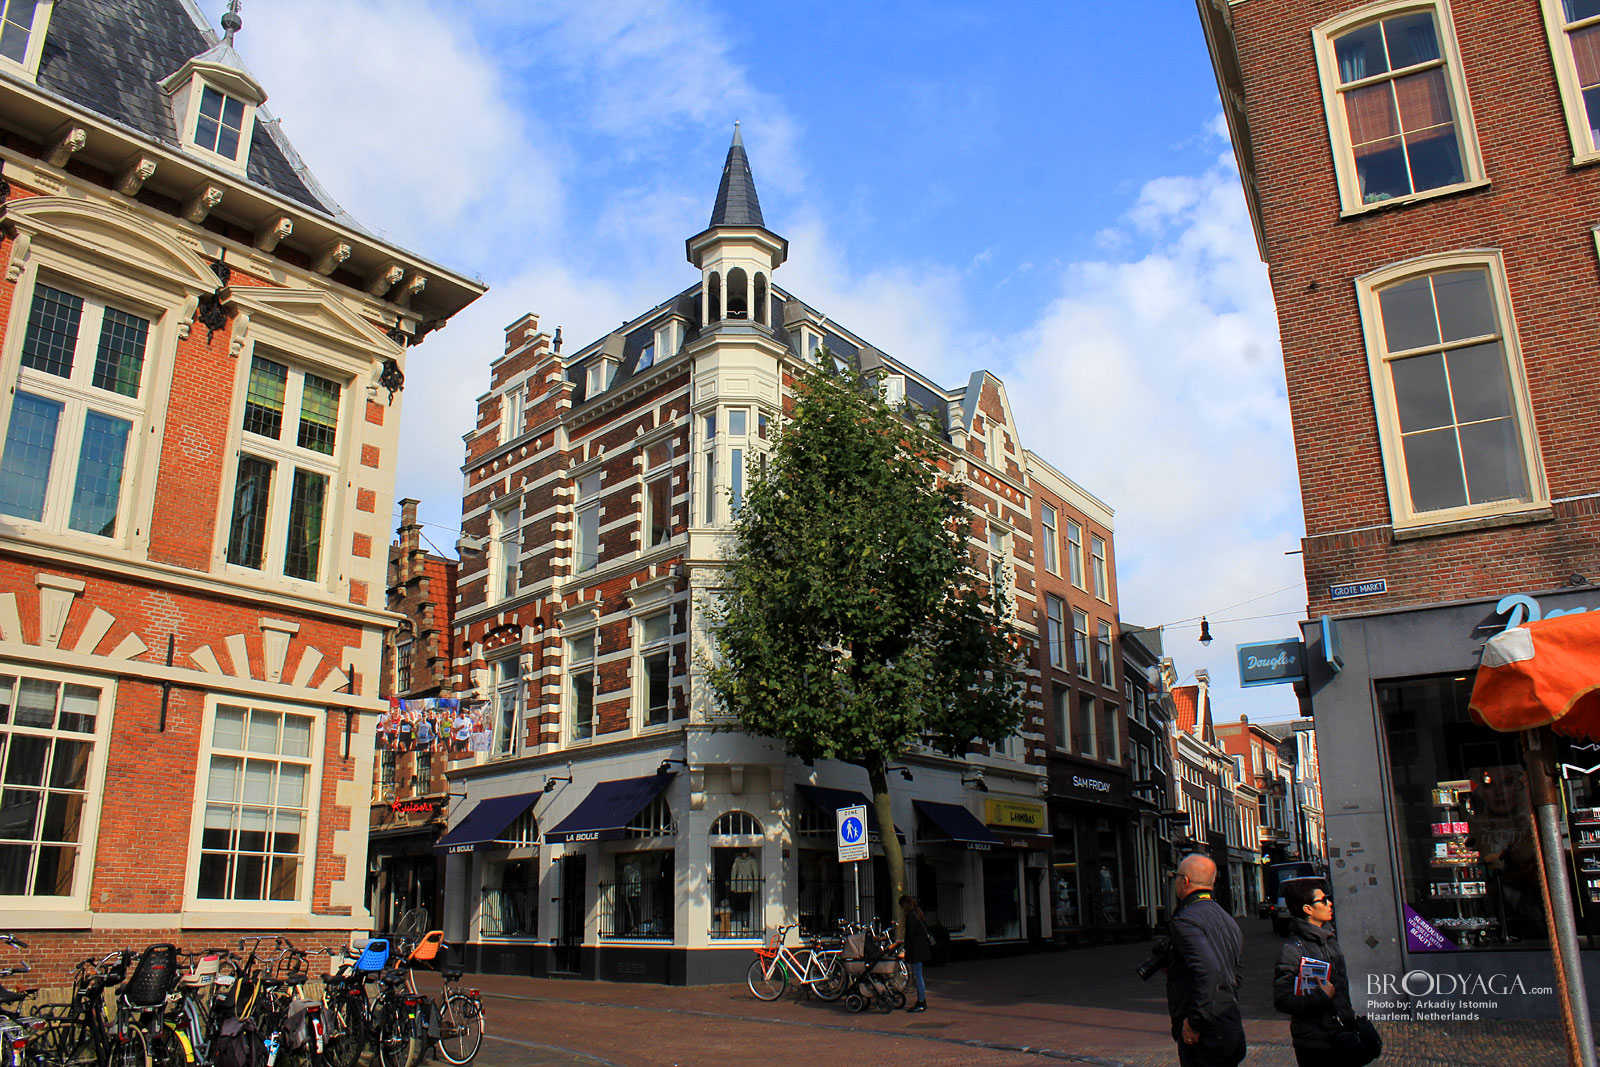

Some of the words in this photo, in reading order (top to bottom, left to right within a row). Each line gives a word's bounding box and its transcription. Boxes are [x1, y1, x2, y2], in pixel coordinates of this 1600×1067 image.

[1334, 586, 1359, 596] GROTE
[1359, 582, 1383, 593] MARKT
[1072, 775, 1088, 788] SAM
[1088, 779, 1111, 793] FRIDAY
[391, 796, 434, 813] Kuipers
[566, 834, 575, 842] LA
[575, 832, 600, 841] BOULE
[457, 844, 475, 852] BOULE
[974, 843, 992, 851] BOULE
[1407, 917, 1431, 939] YOURSELF
[1428, 935, 1444, 949] WITH
[1410, 927, 1433, 947] BEAUTY
[1413, 915, 1445, 943] SURROUND
